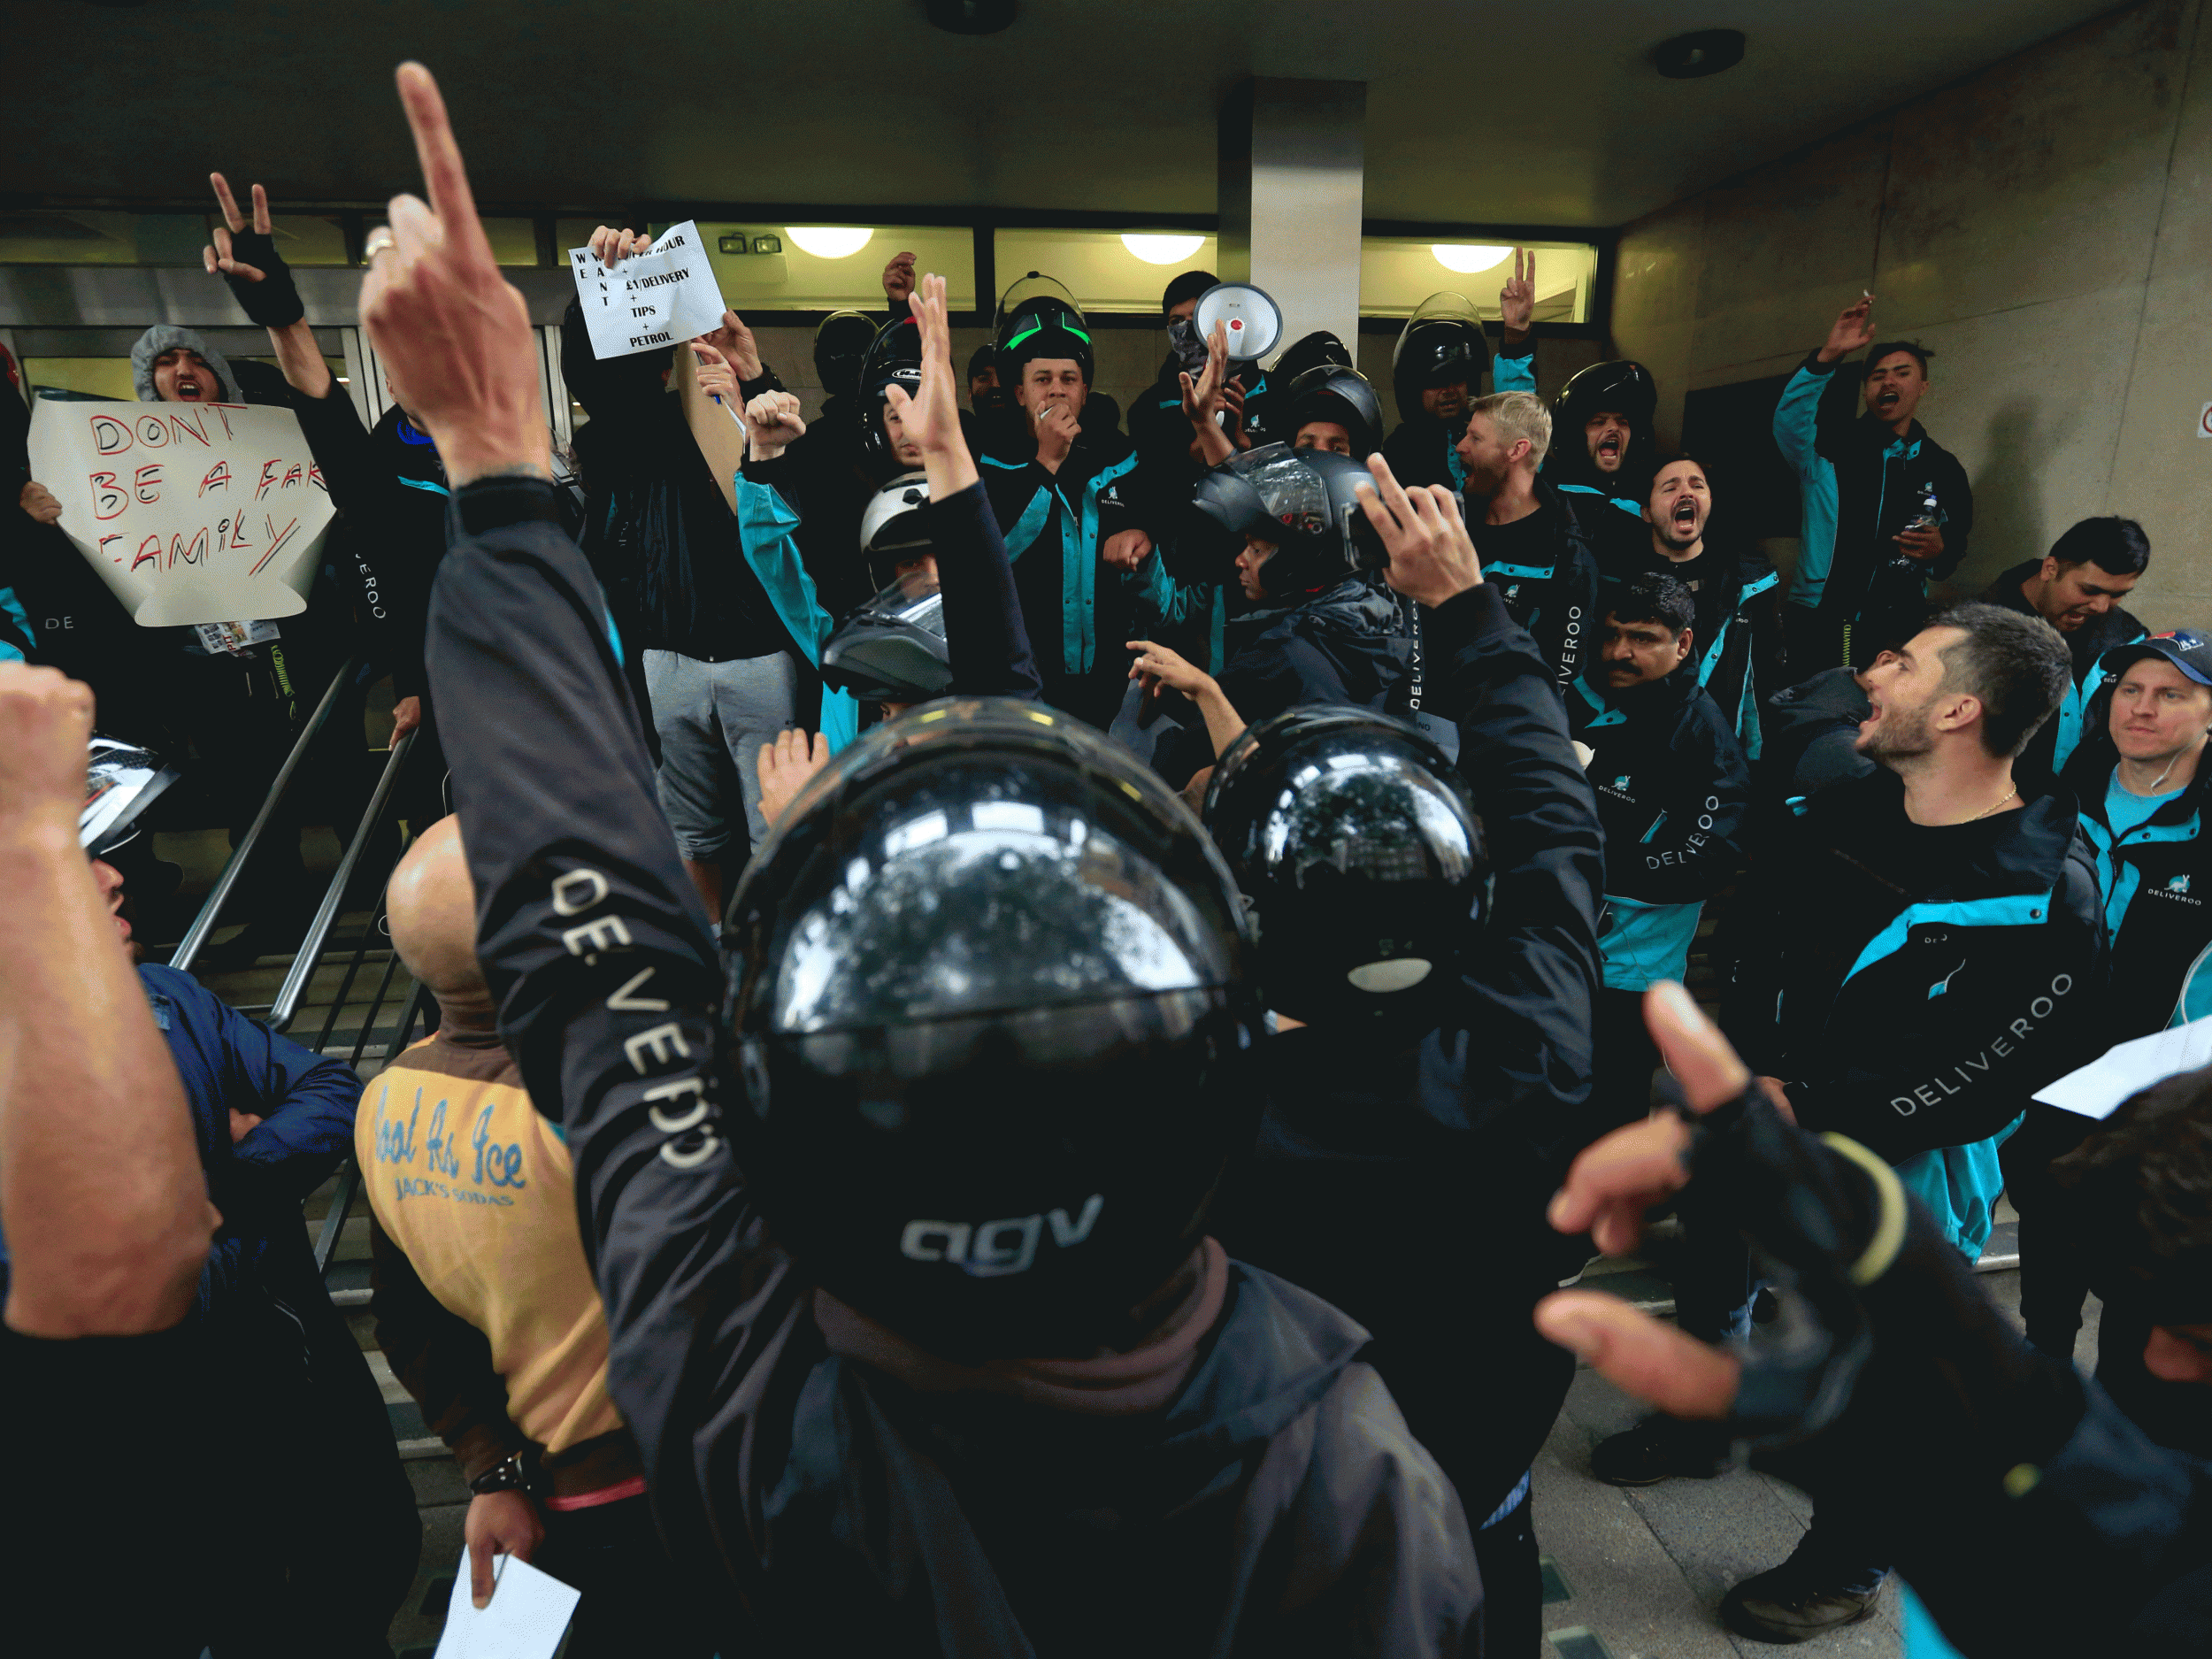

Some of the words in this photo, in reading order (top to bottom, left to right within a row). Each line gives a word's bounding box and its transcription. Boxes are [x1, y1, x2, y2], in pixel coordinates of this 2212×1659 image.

[626, 267, 690, 292] £1/DELIVERY
[630, 304, 657, 318] TIPS
[629, 331, 674, 347] PETROL
[89, 403, 248, 456] DON'T
[89, 464, 165, 520] BE
[197, 460, 232, 498] A
[355, 553, 387, 619] EROO
[1557, 605, 1582, 696] IVEROO
[1598, 785, 1636, 803] DELIVEROO
[2147, 887, 2201, 906] DELIVEROO
[1890, 972, 2072, 1117] DELIVEROO
[472, 1104, 526, 1189] Ice
[395, 1176, 449, 1202] JACK'S
[452, 1187, 515, 1207] SODAS
[899, 1193, 1105, 1279] agv
